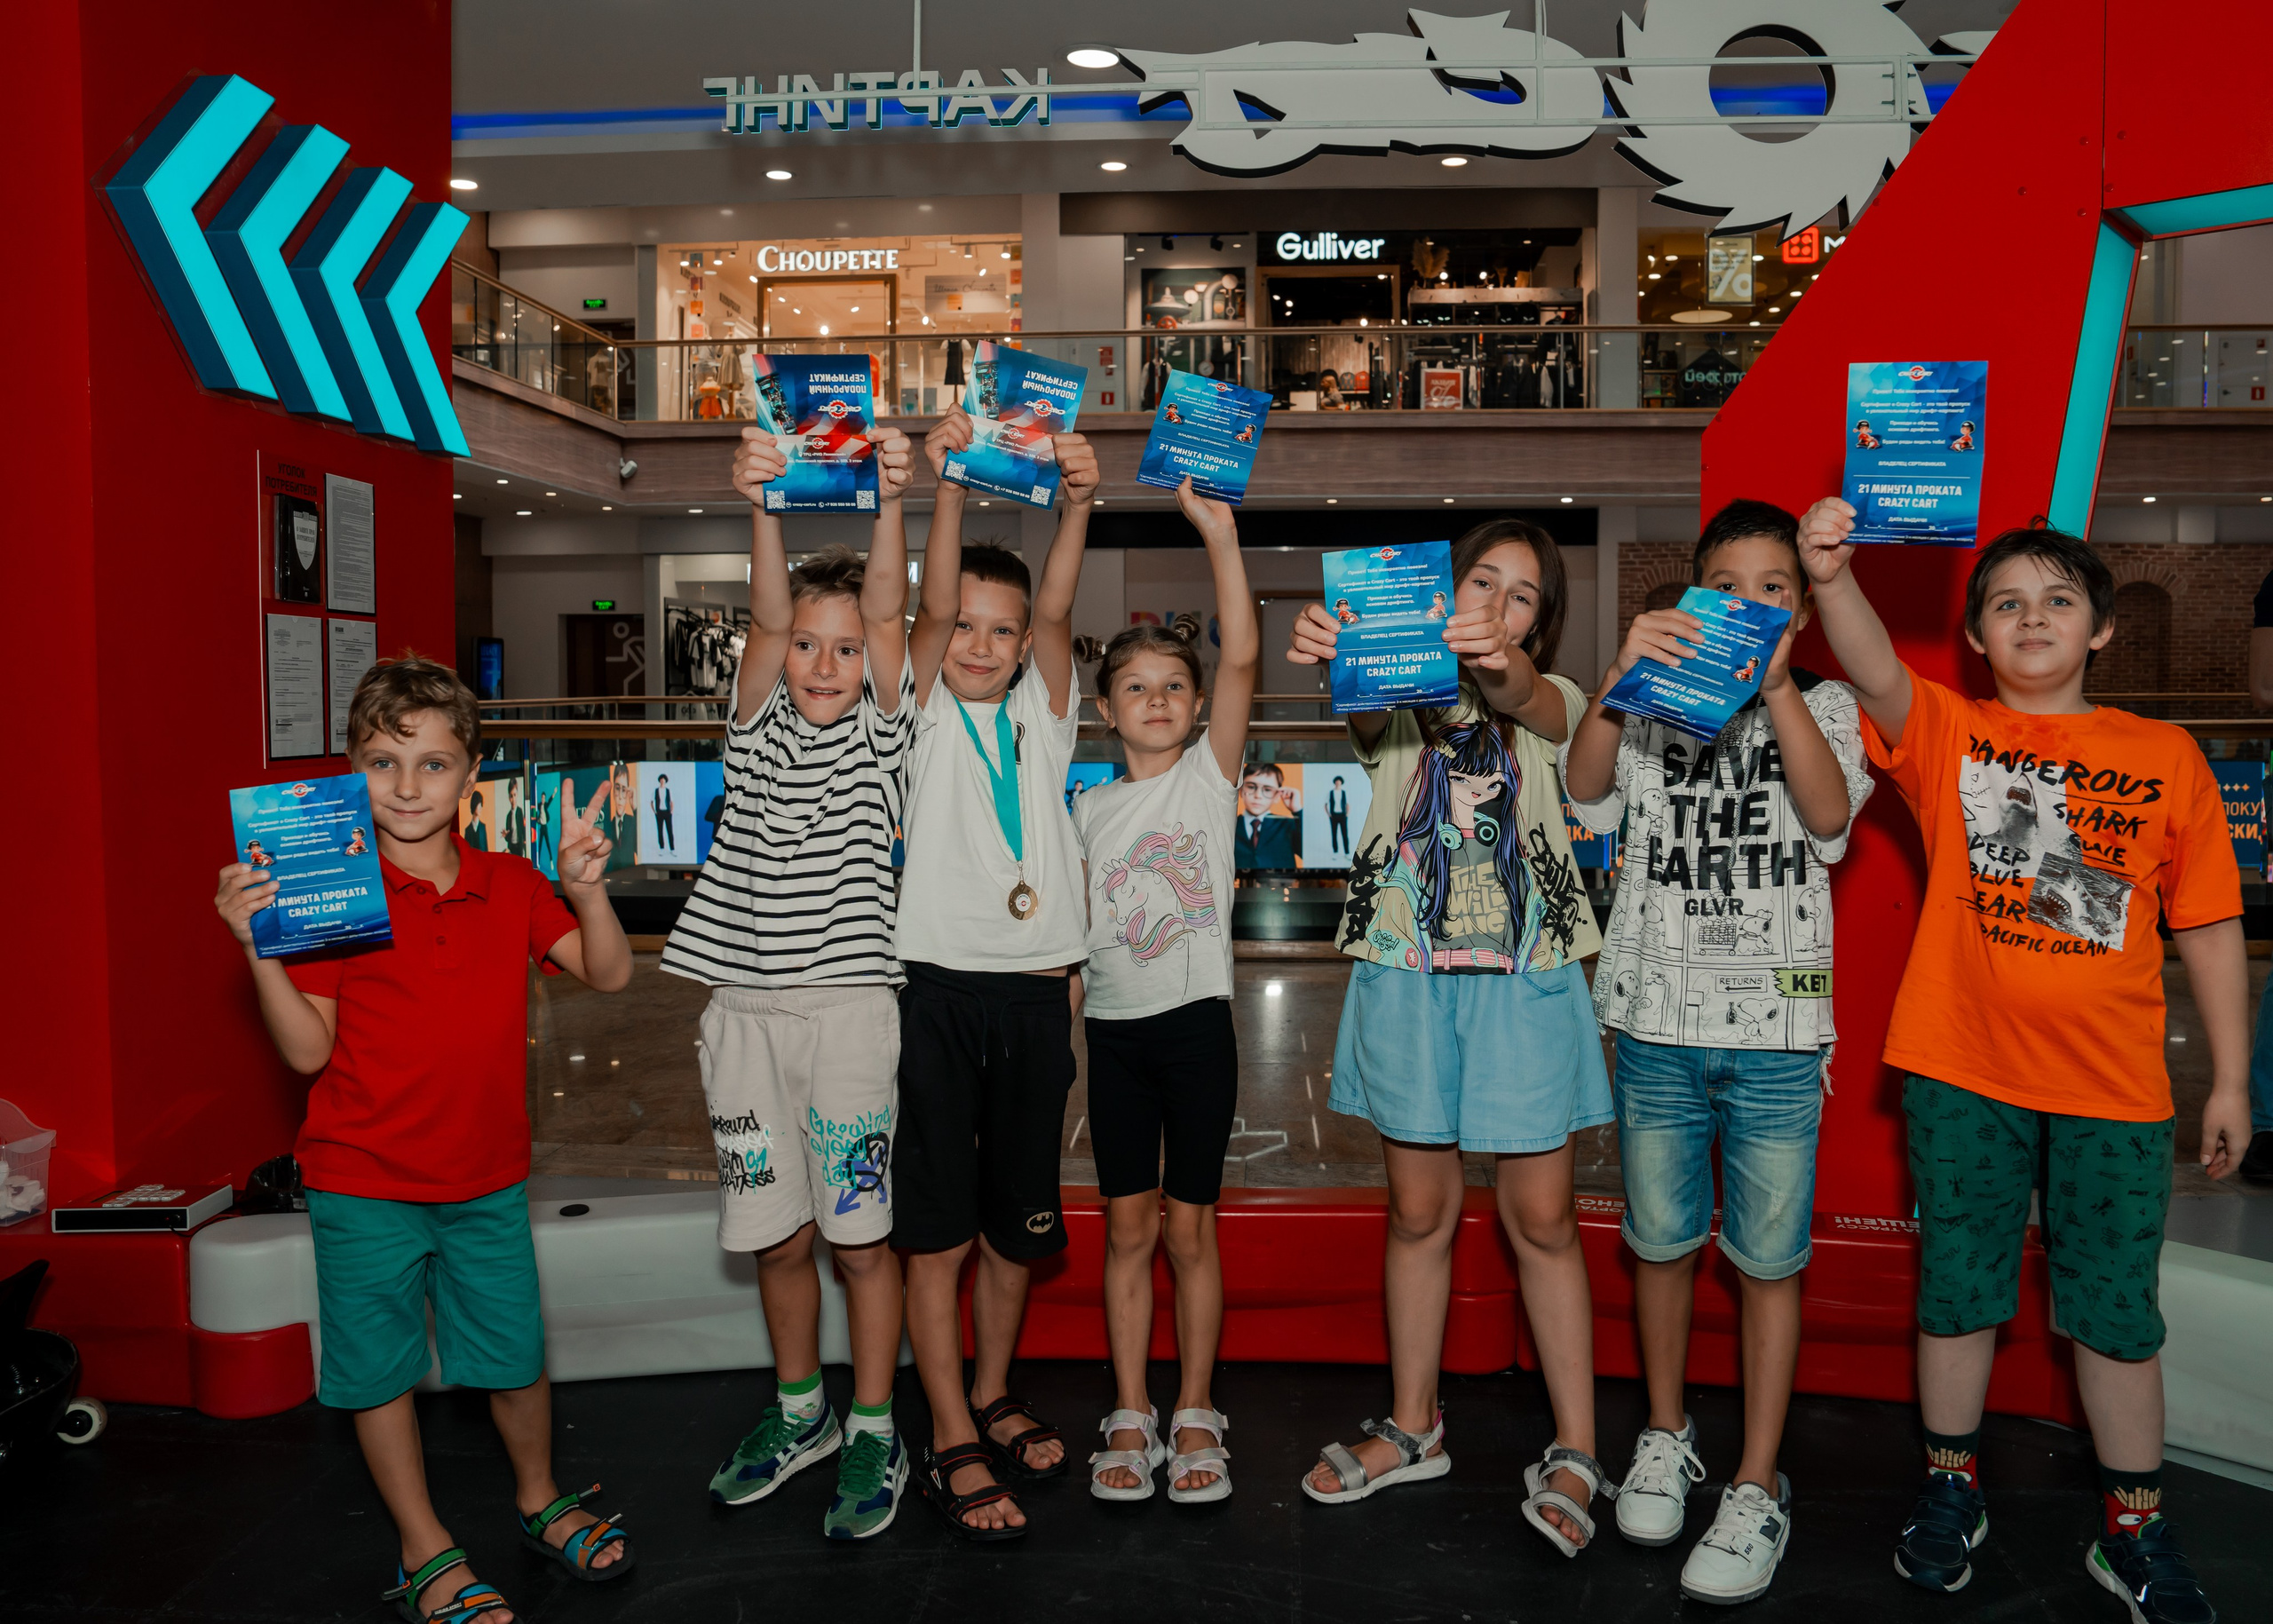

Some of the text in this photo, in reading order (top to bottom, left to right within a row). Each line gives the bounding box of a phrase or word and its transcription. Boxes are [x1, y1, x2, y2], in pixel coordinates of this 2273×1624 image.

[1276, 232, 1385, 260] Gulliver
[810, 373, 866, 383] СЕРТИФИКАТ
[1025, 370, 1079, 390] СЕРТИФИКАТ
[809, 384, 867, 394] ПОДАРОЧНЫЙ
[1022, 380, 1077, 400] ПОДАРОЧНЫЙ
[1168, 446, 1202, 459] МИНУТА
[1203, 454, 1238, 468] ПРОКАТА
[1172, 456, 1220, 472] CRAZY CART
[278, 462, 305, 478] УГОЛОК
[265, 476, 317, 497] ПОТРЕБИТЕЛЯ
[1857, 484, 1962, 495] 21 МИНУТА ПРОКАТА
[1878, 497, 1938, 508] CRAZY CART
[1345, 650, 1442, 667] 21 МИНУТА ПРОКАТА
[1366, 664, 1422, 677] CRAZY CART
[1640, 671, 1726, 706] 21 МИНУТА ПРОКАТА
[1651, 685, 1701, 706] CRAZY CART
[1664, 740, 1786, 789] SAVE
[1670, 790, 1769, 838] THE
[2054, 803, 2148, 839] SHARK
[1968, 832, 2030, 867] DEEP
[1970, 861, 2024, 888] BLUE
[277, 893, 320, 907] МИНУТА
[321, 886, 368, 900] ПРОКАТА
[288, 902, 348, 918] CRAZY CART
[1684, 899, 1744, 916] GLVR
[2051, 939, 2110, 956] OCEAN
